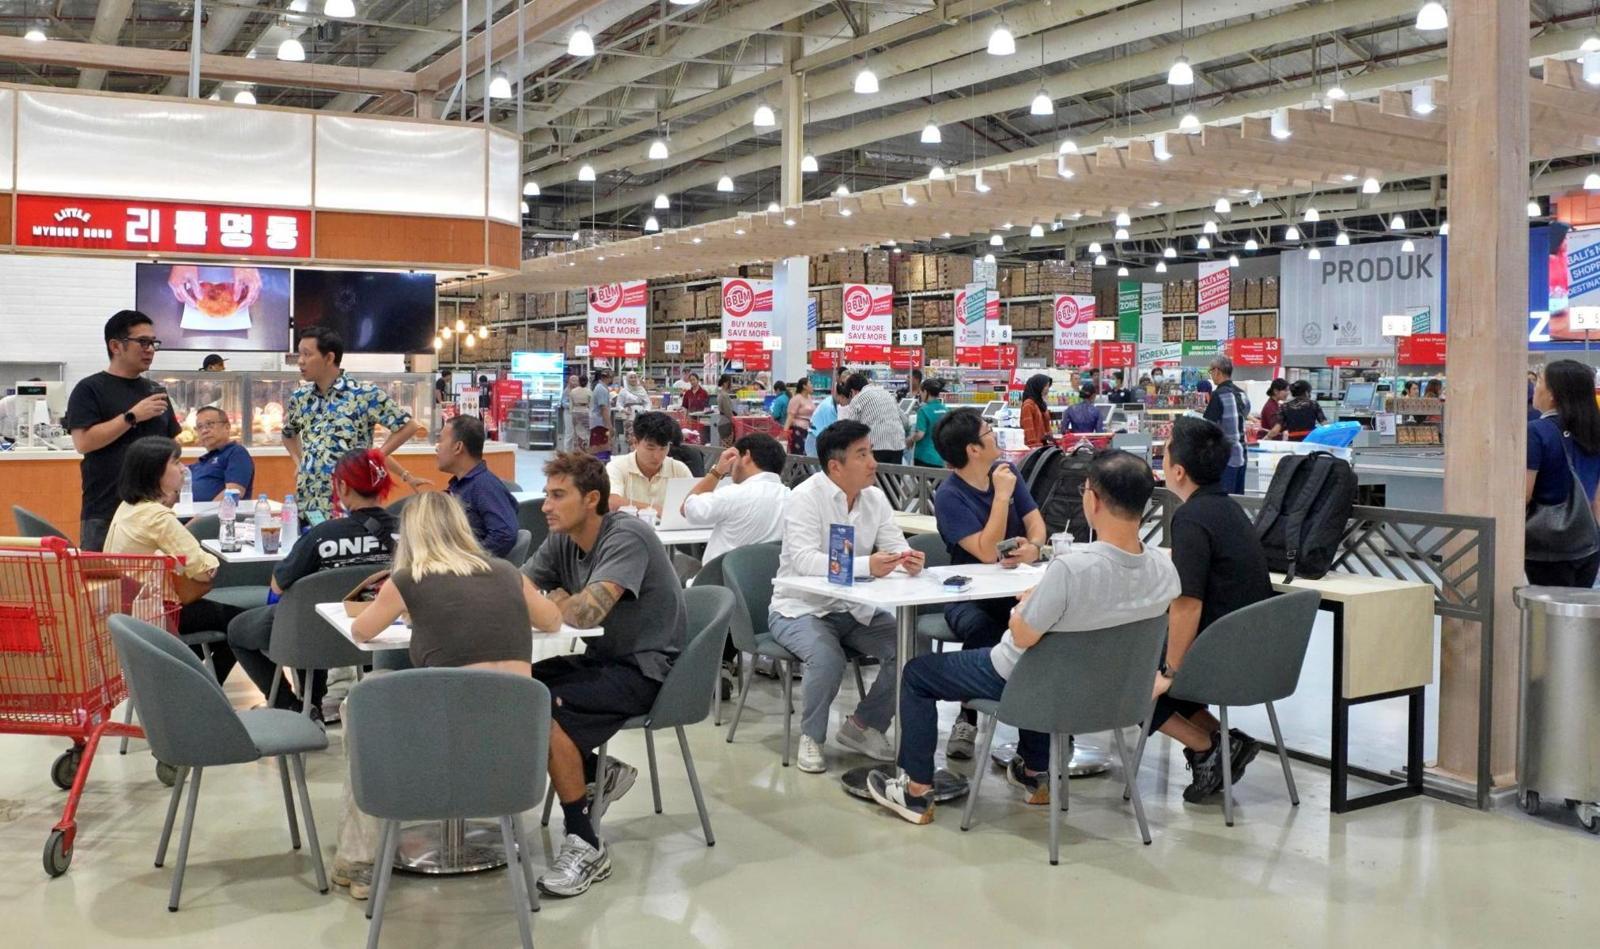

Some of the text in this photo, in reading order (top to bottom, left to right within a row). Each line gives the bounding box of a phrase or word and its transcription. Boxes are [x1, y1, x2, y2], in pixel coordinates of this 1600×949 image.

[54, 208, 91, 222] LITTLE
[1568, 247, 1595, 265] BALI's
[1322, 253, 1433, 284] PRODUK
[1120, 300, 1139, 310] ZONE
[1143, 302, 1161, 310] ZONE
[616, 327, 640, 335] MORE
[728, 329, 747, 337] SAVE
[1121, 344, 1132, 353] 15
[1265, 341, 1278, 350] 13
[1140, 348, 1169, 361] HOREKA
